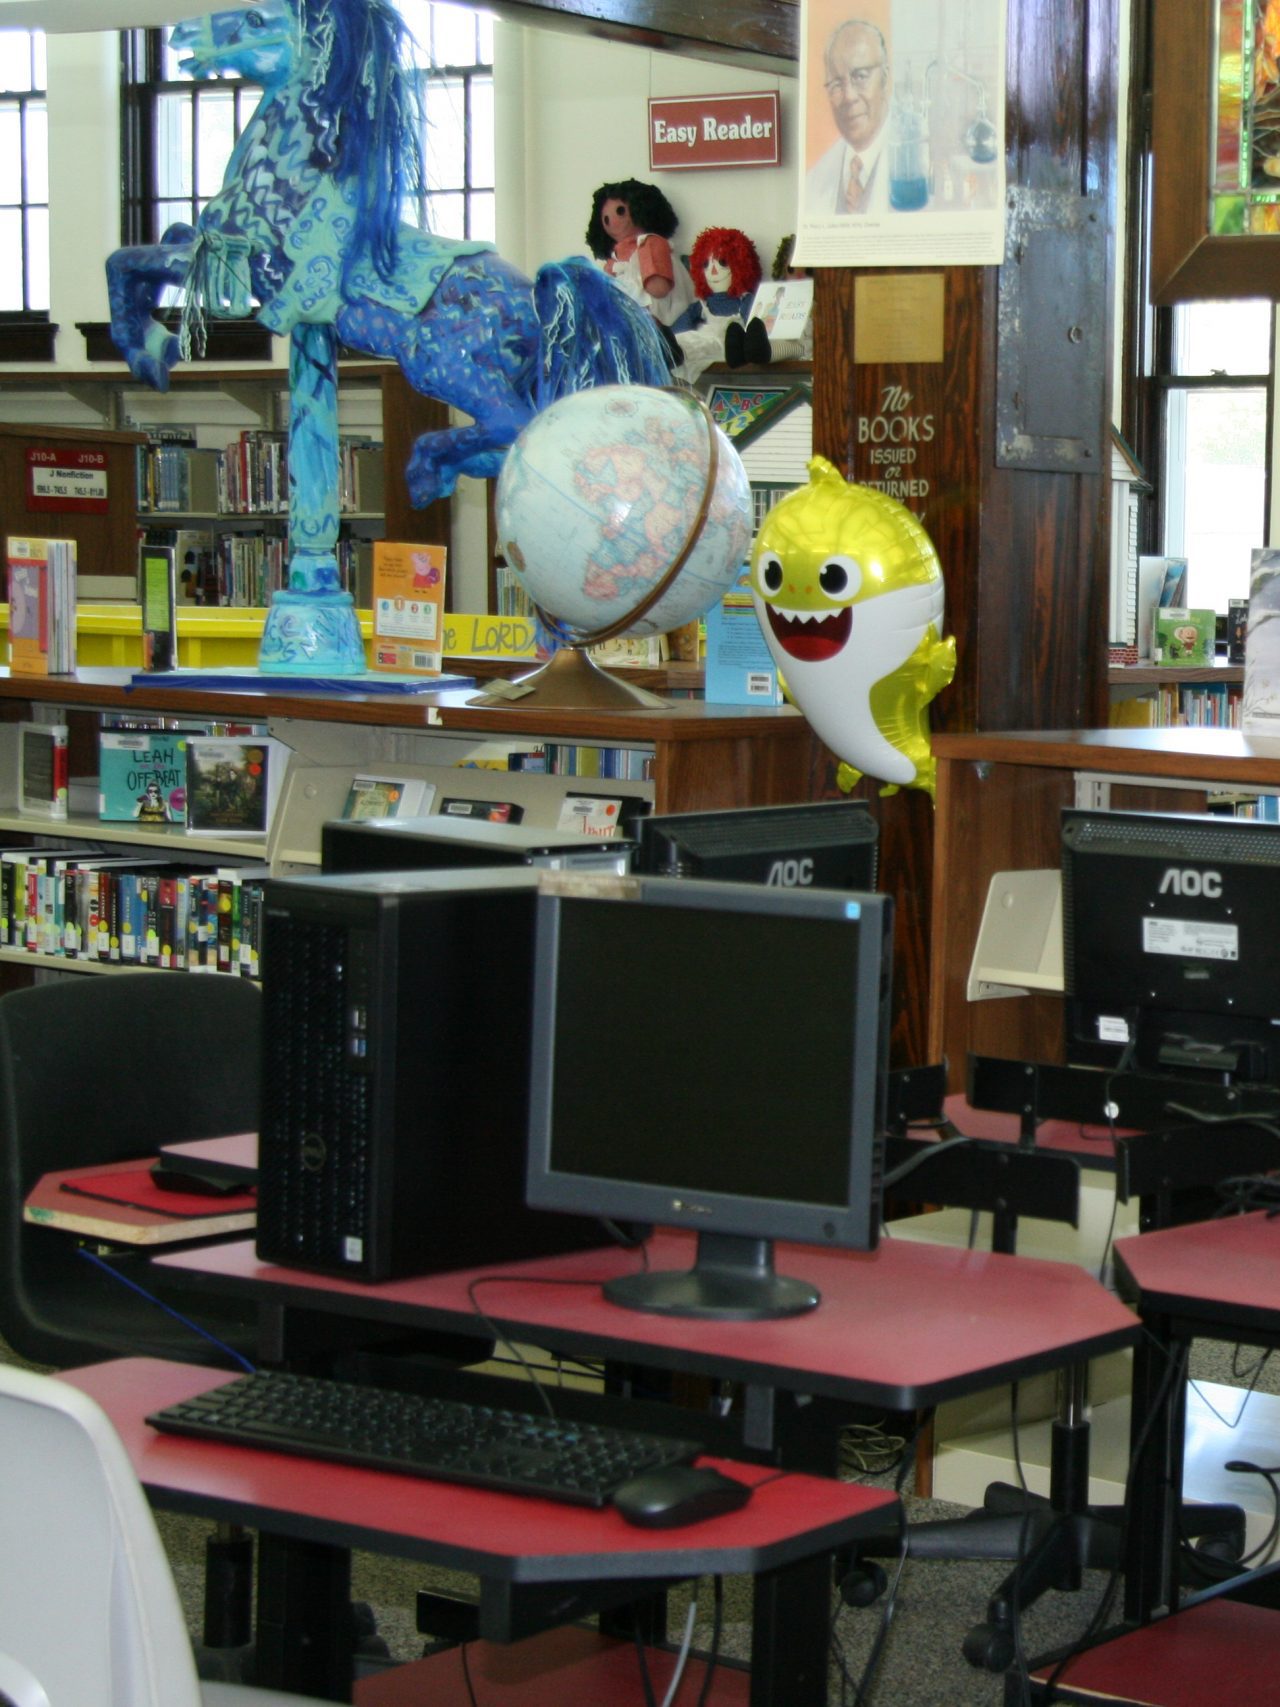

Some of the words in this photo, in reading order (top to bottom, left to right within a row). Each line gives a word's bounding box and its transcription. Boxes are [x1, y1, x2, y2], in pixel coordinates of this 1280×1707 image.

[654, 120, 697, 147] Easy
[703, 114, 772, 141] Reader
[881, 385, 913, 412] No
[858, 414, 935, 443] BOOKS
[30, 452, 57, 462] J10-A
[78, 454, 105, 464] J10-B
[870, 447, 917, 464] ISSUED
[56, 470, 94, 480] Nonfiction
[132, 748, 174, 765] LEAH
[766, 858, 815, 887] AOC
[1158, 868, 1223, 898] AOC
